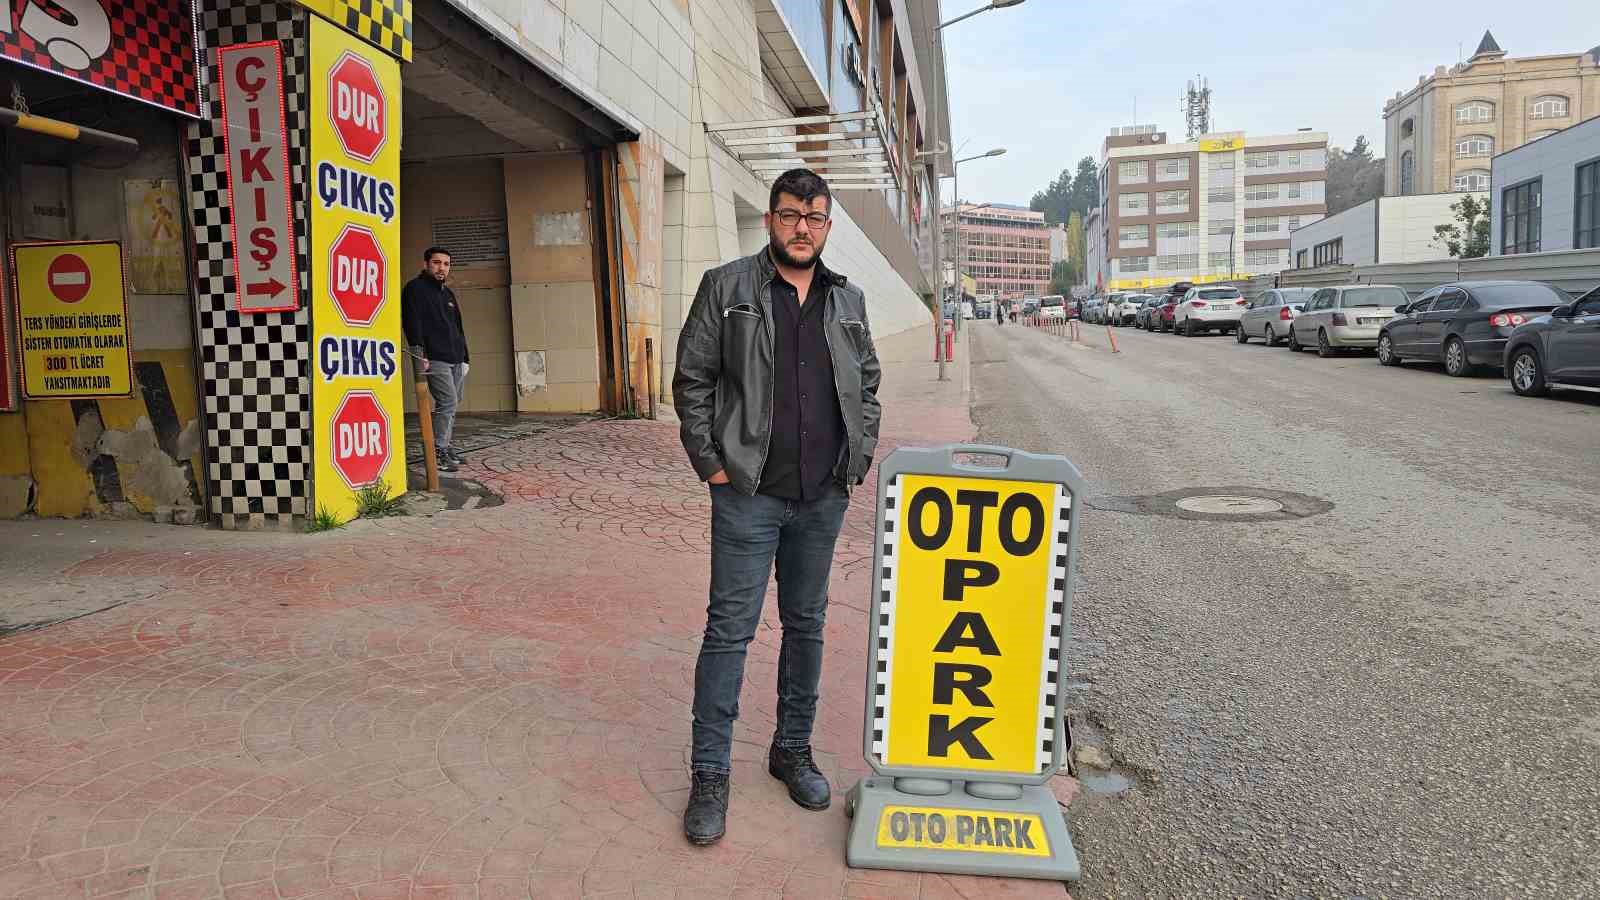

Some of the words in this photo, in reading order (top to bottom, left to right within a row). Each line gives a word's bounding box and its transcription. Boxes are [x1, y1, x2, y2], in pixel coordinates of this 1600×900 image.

[337, 81, 380, 134] DUR
[235, 56, 278, 271] ÇIKIŞ
[317, 162, 395, 223] ÇIKIŞ
[337, 254, 379, 297] DUR
[24, 317, 43, 330] TERS
[78, 312, 122, 331] GİRİŞLERDE
[25, 336, 52, 350] SİSTEM
[53, 333, 92, 349] OTOMATİK
[94, 335, 124, 348] OLARAK
[46, 356, 67, 371] 300
[70, 356, 79, 369] TL
[80, 354, 104, 369] ÜCRET
[319, 337, 396, 381] ÇIKIŞ
[339, 421, 382, 458] DUR
[907, 486, 1045, 557] OTO
[927, 558, 1003, 761] PARK
[890, 811, 946, 844] OTO
[957, 815, 1036, 849] PARK
